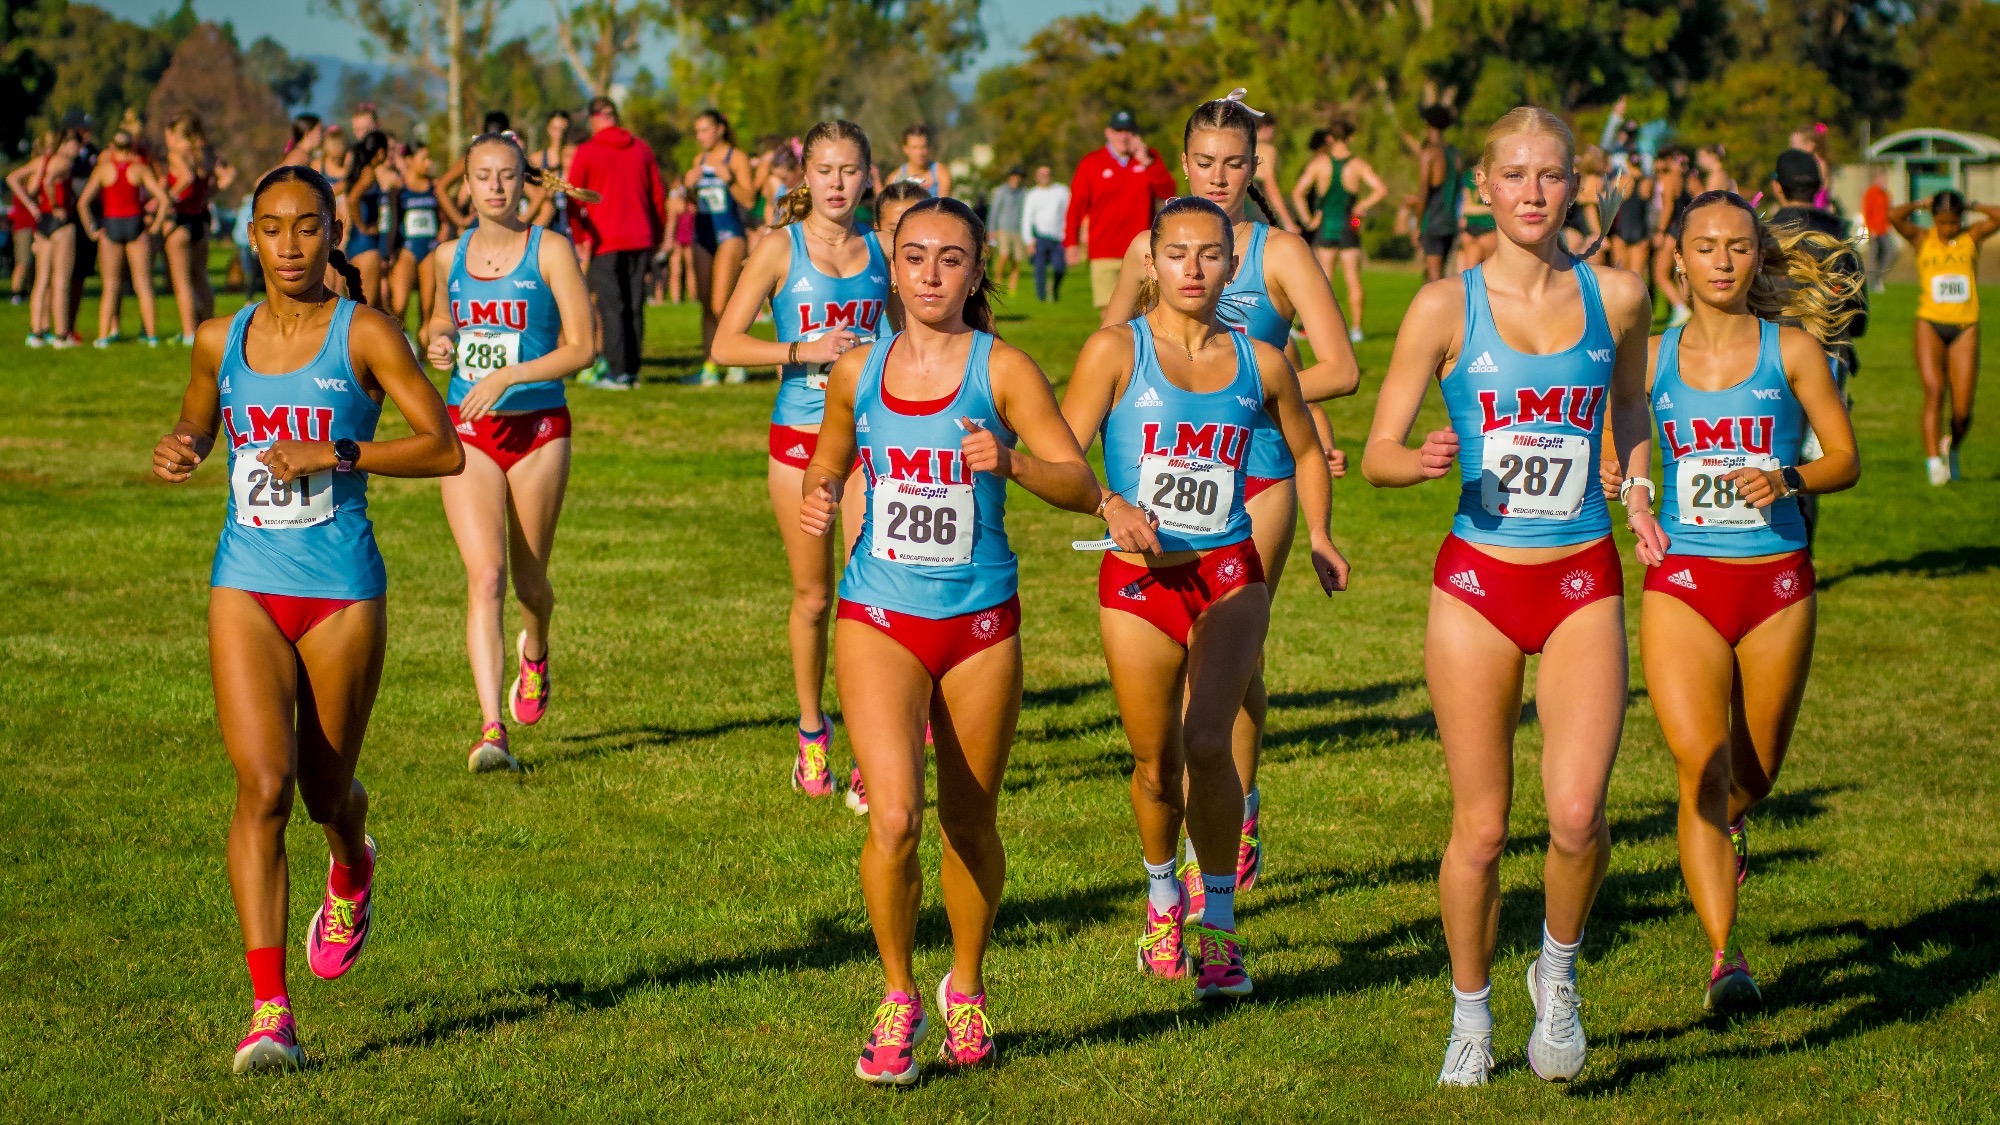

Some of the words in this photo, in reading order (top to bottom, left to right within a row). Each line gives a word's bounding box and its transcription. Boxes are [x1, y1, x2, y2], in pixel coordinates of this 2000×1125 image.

[451, 299, 529, 332] LMU
[797, 298, 884, 336] LMU
[464, 342, 508, 370] 283
[1585, 348, 1612, 363] WCC
[1467, 364, 1499, 374] adidas
[313, 377, 349, 392] WCC
[1751, 388, 1782, 400] WCC
[1134, 399, 1164, 408] adidas
[1477, 384, 1606, 436] LMU
[222, 404, 335, 452] LMU
[1138, 420, 1251, 472] LMU
[1512, 434, 1564, 450] MileSplit
[1662, 415, 1776, 462] LMU
[859, 445, 977, 491] LMU
[1167, 457, 1214, 473] MileSplit
[1701, 456, 1747, 469] MileSplit
[1497, 453, 1574, 497] 287
[247, 468, 311, 507] 291
[897, 482, 949, 500] MileSplit
[1151, 472, 1219, 516] 280
[1512, 507, 1569, 516] REDCAPTIMING.COM
[887, 501, 957, 546] 286
[899, 553, 955, 563] REDCAPTIMING.COM
[1449, 575, 1486, 597] adidas
[1667, 575, 1698, 590] adidas
[1118, 589, 1147, 601] adidas
